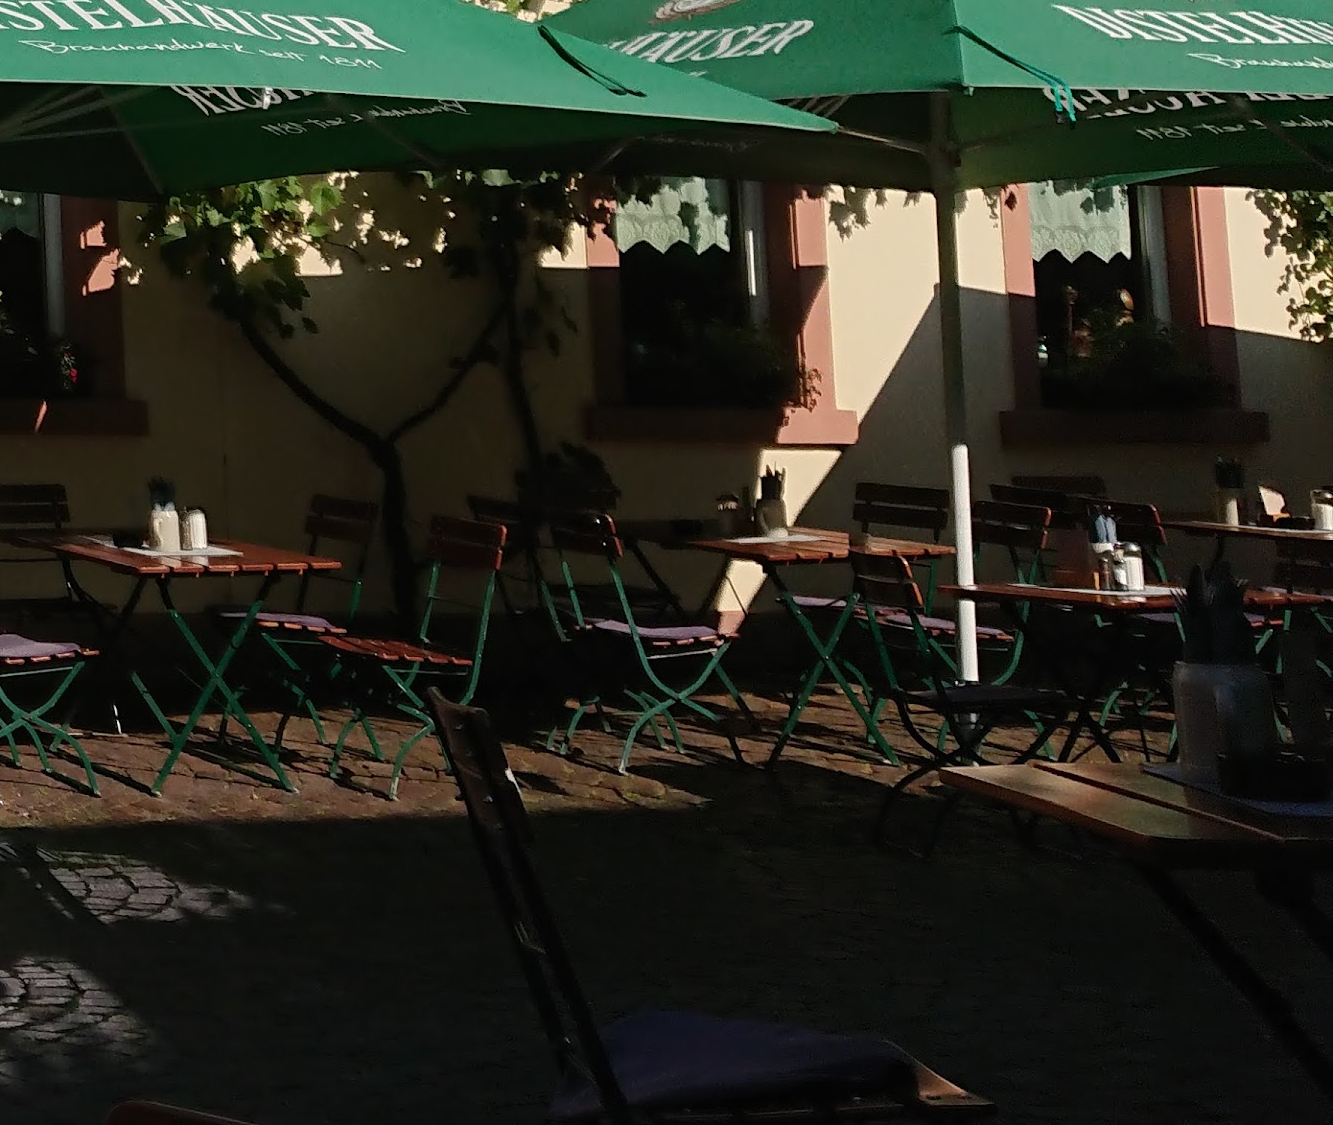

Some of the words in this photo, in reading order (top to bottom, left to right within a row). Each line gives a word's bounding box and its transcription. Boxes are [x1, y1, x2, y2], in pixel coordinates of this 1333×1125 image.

[19, 38, 255, 56] Brauhandwerk
[259, 48, 307, 63] seit
[319, 53, 383, 70] 1811
